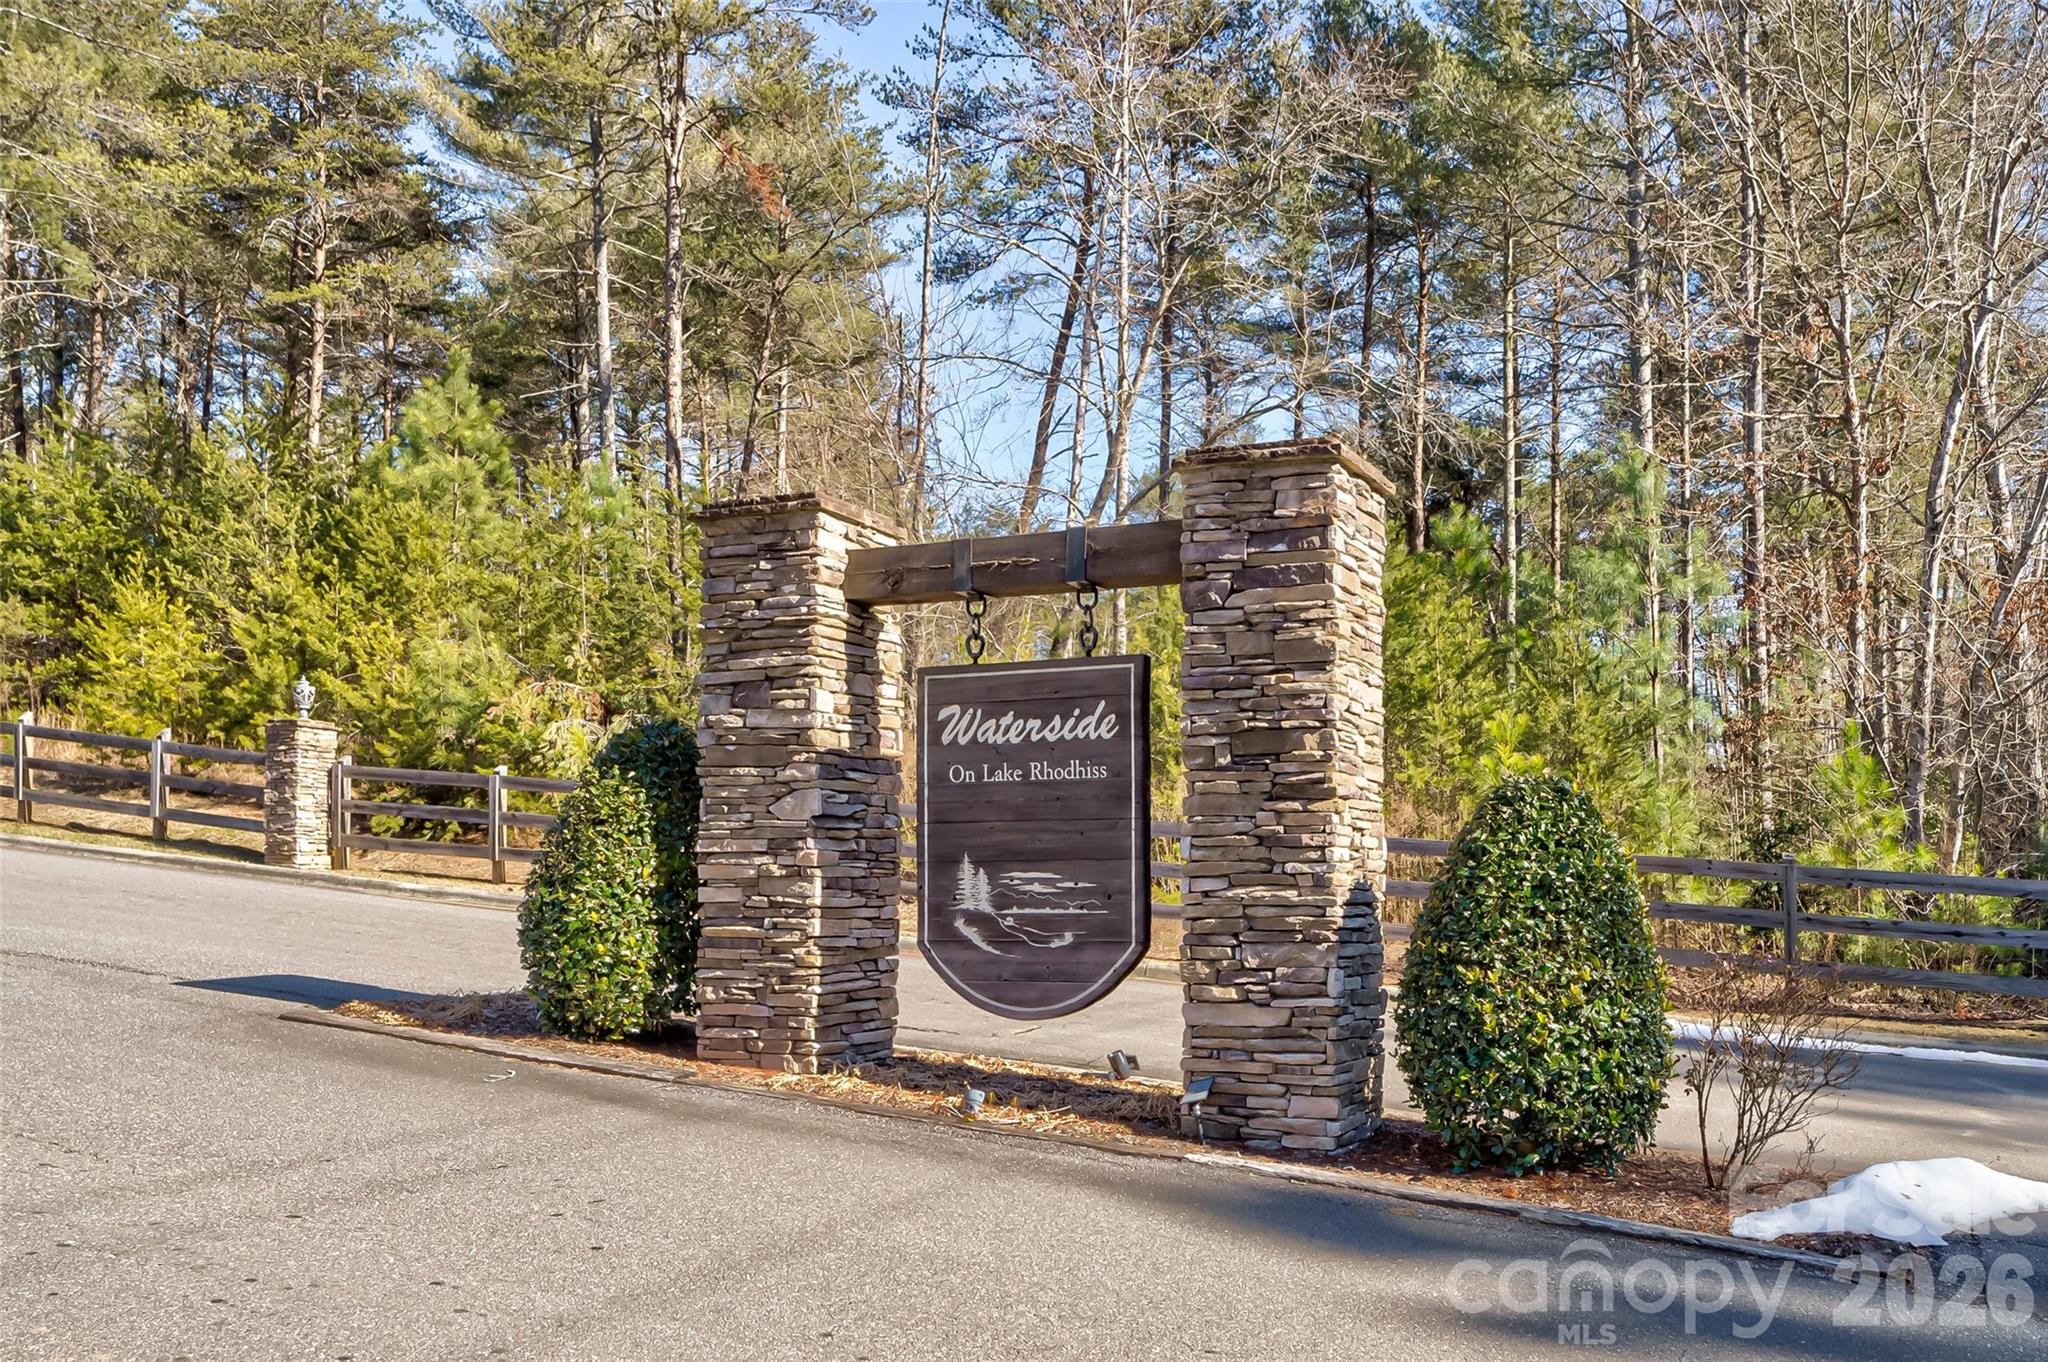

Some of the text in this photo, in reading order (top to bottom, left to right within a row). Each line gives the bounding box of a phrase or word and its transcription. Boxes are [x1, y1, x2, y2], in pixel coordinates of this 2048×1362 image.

[937, 700, 1119, 746] Waterside
[949, 760, 1108, 783] On Lake Rhodhiss
